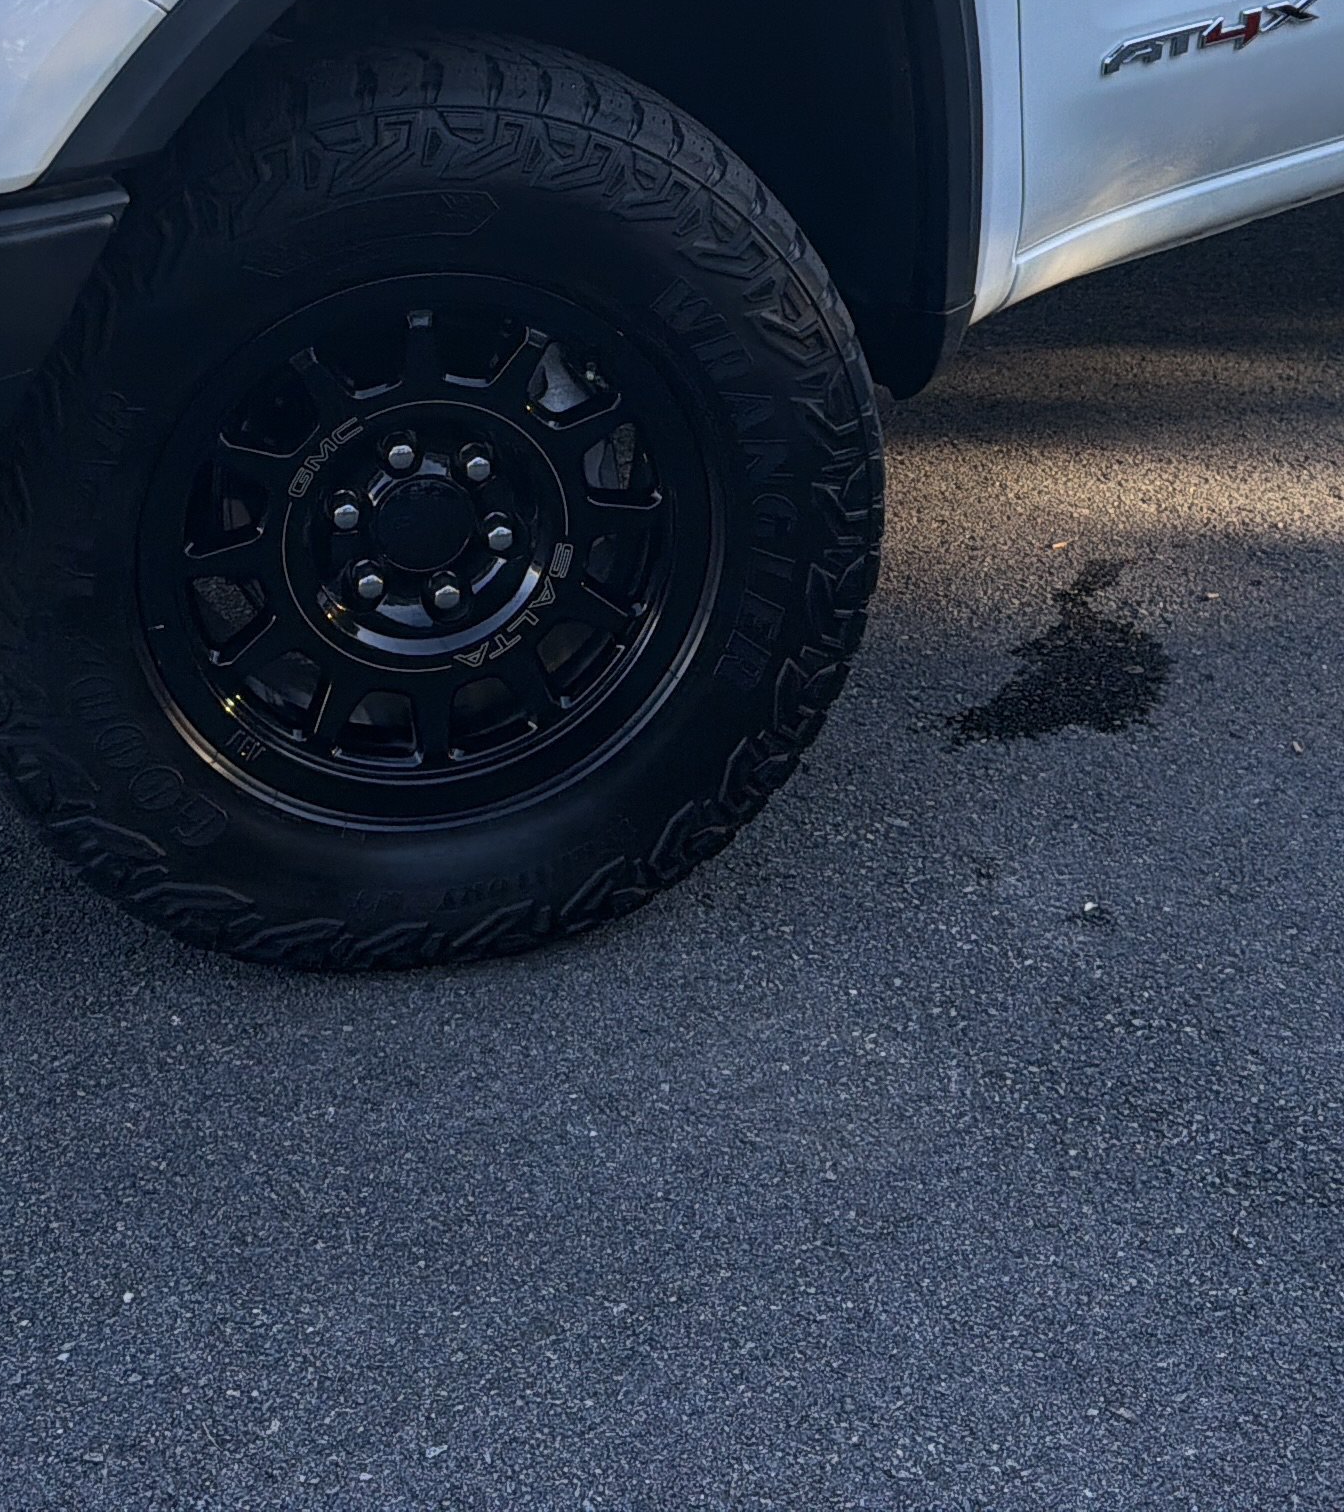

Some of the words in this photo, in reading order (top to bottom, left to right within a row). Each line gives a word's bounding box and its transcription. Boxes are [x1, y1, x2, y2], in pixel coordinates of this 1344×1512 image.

[288, 416, 365, 499] GMC
[651, 275, 799, 691] WRANGLER
[453, 541, 575, 669] SALTA
